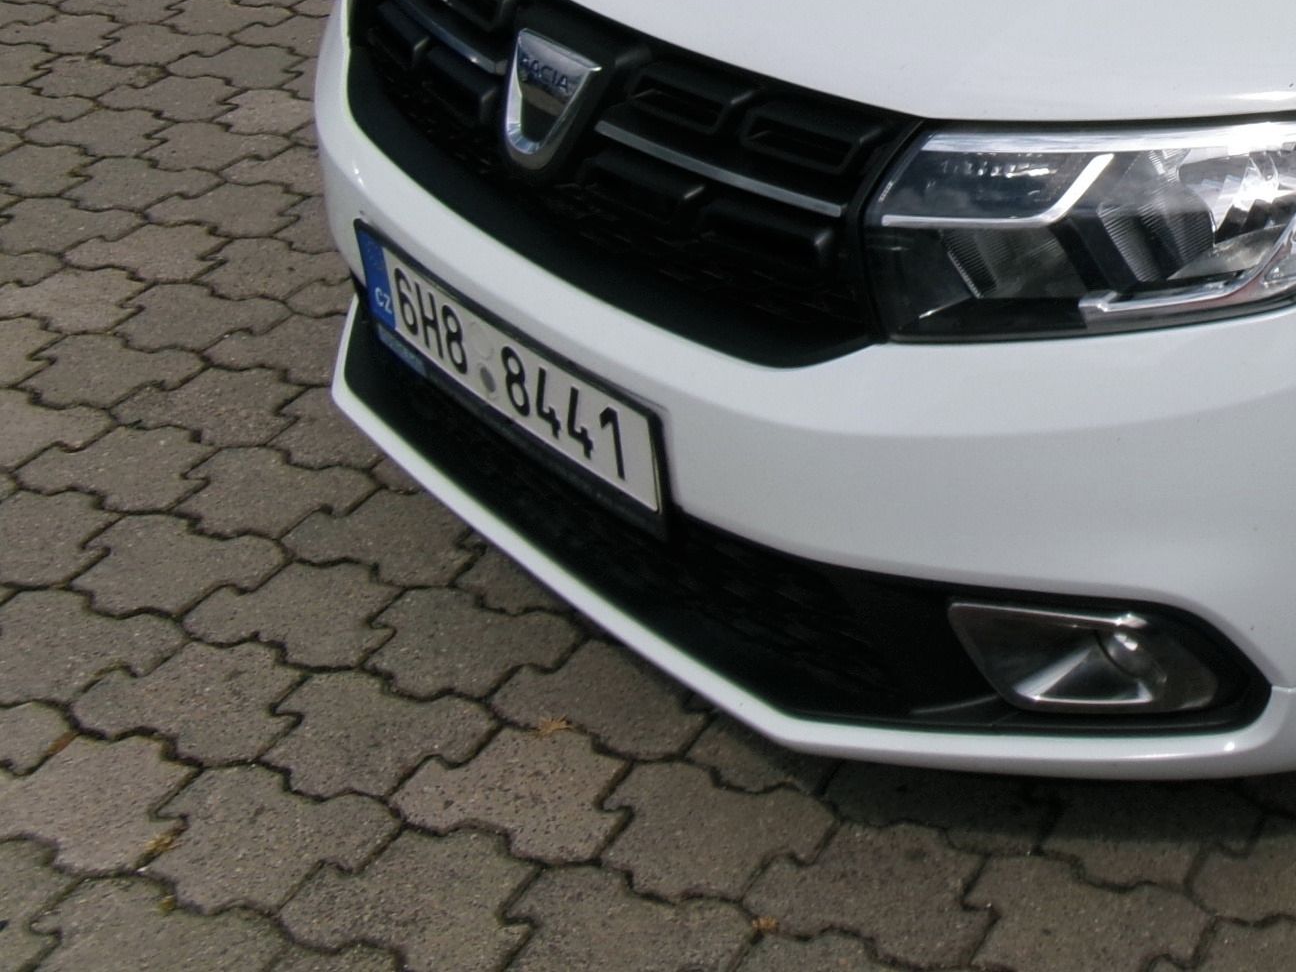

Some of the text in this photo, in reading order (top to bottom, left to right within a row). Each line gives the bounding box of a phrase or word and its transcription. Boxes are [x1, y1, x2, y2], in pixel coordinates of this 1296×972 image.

[375, 287, 393, 315] CZ
[394, 267, 626, 481] 6H8 8441
